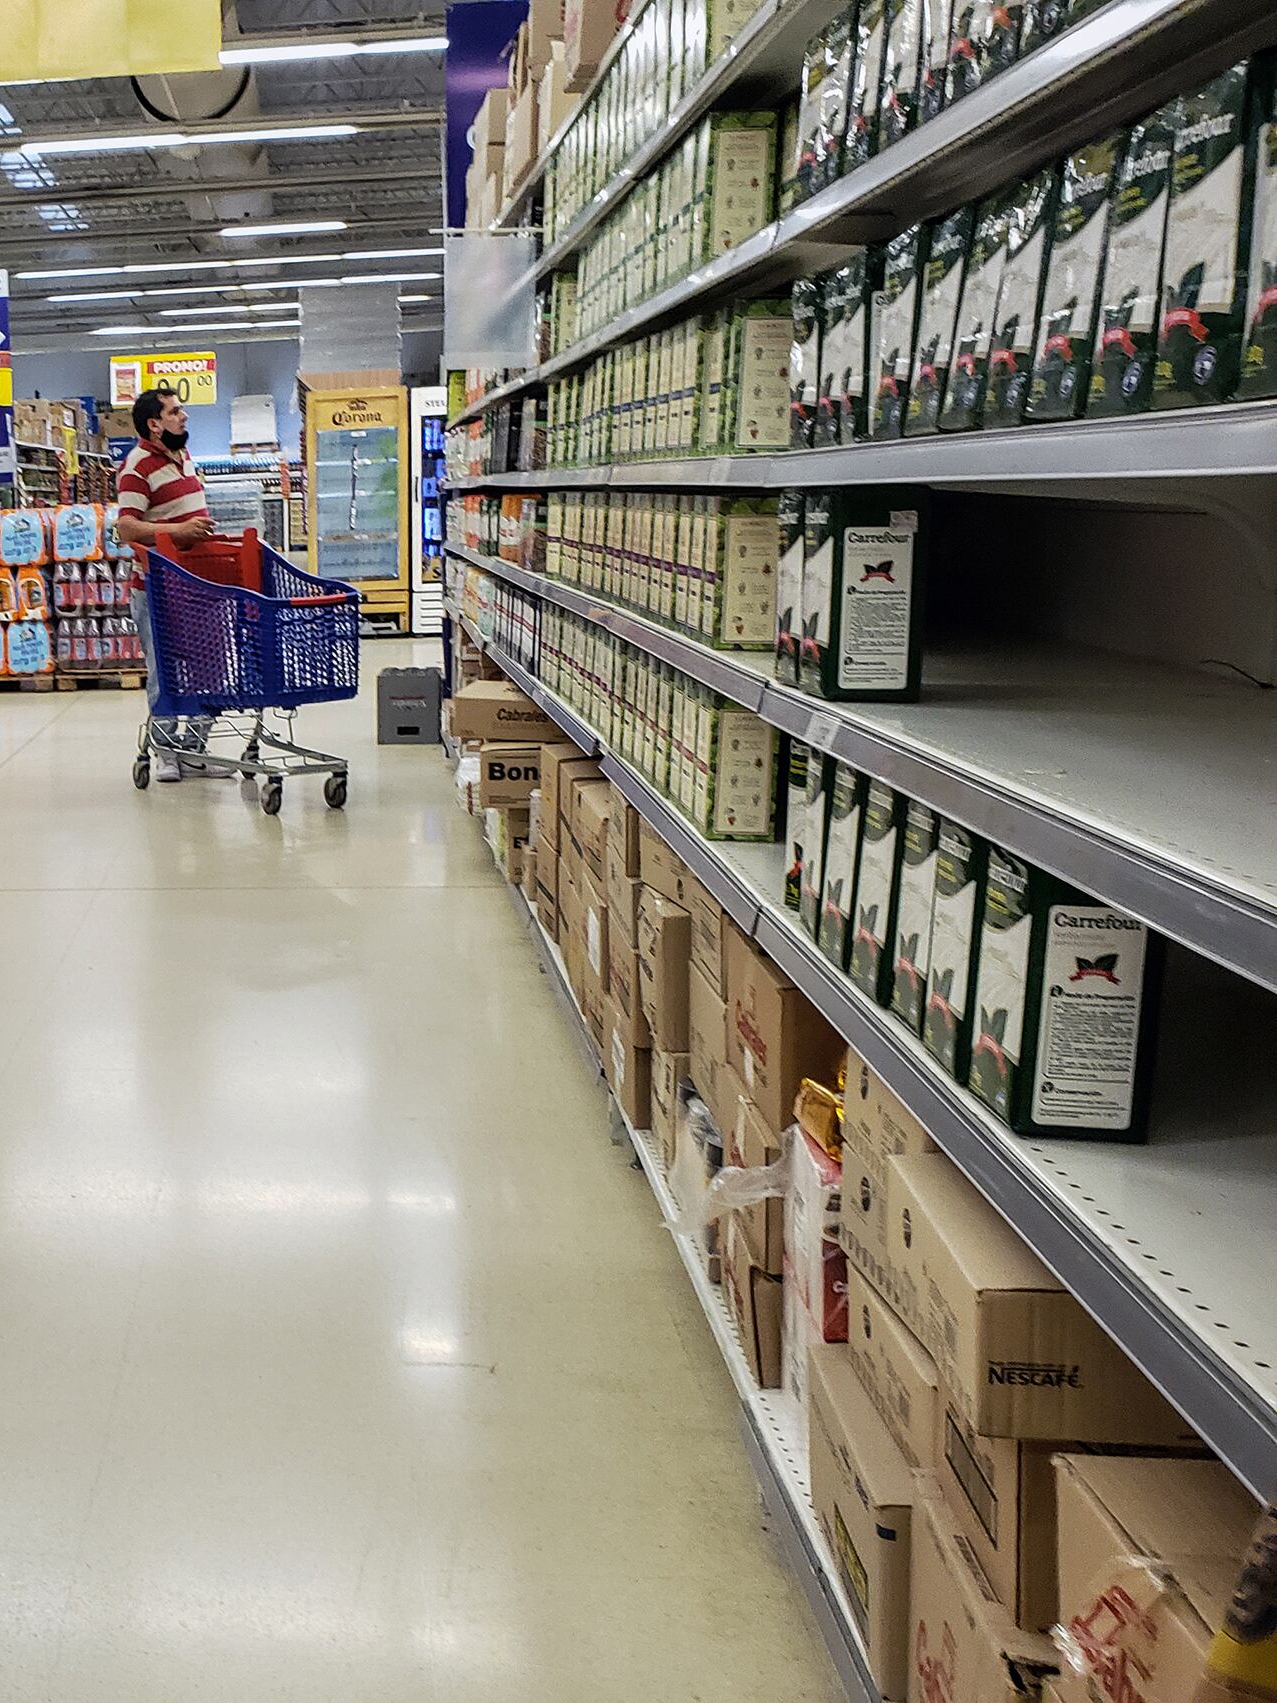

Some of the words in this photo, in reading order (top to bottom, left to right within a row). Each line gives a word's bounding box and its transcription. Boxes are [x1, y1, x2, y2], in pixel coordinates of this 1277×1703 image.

[153, 360, 208, 374] PROMO!
[332, 411, 383, 426] Corona
[488, 762, 540, 781] Bon
[1054, 912, 1142, 932] Carrefour
